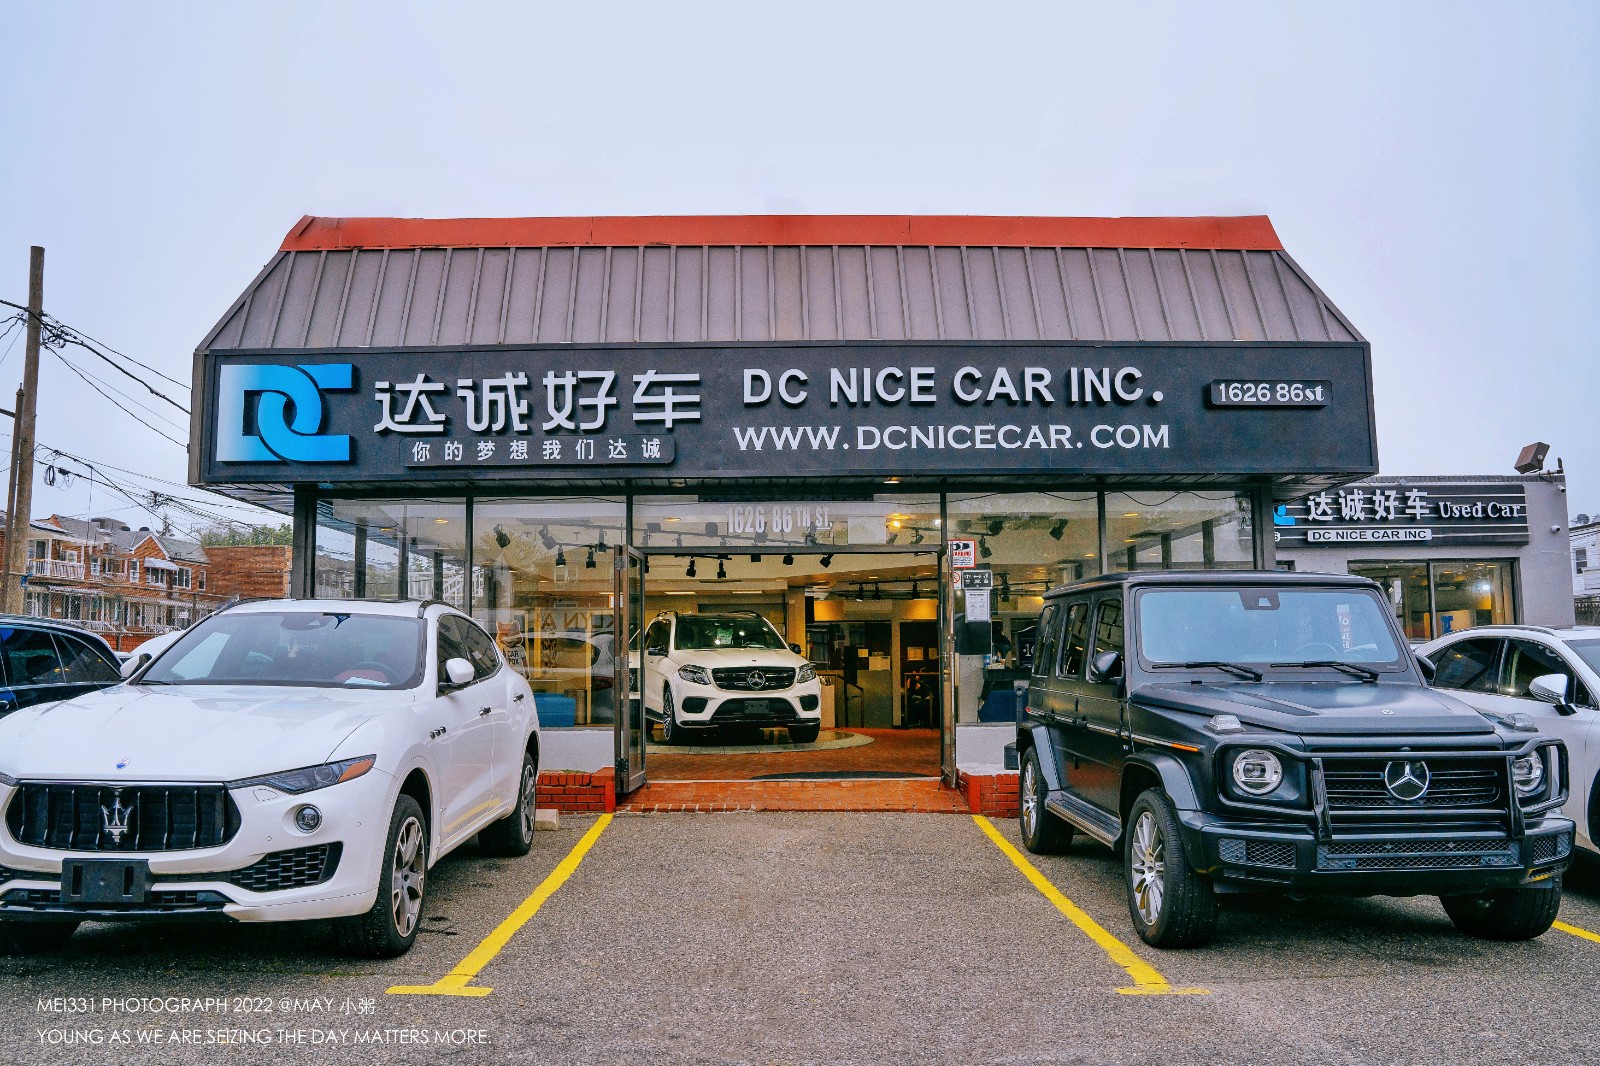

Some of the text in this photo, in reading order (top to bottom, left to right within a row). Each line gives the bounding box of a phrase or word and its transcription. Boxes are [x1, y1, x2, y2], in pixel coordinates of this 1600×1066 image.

[743, 366, 1164, 404] DC NICE CAR INC.
[1219, 383, 1271, 402] 1626
[216, 363, 352, 462] DC
[373, 370, 701, 432] 达诚好车
[411, 438, 661, 462] 你的梦想我们达诚
[727, 505, 765, 534] 1626
[1307, 489, 1430, 521] 达诚好车
[1439, 501, 1520, 518] Used Car
[1312, 530, 1427, 540] DC NICE CAR INC
